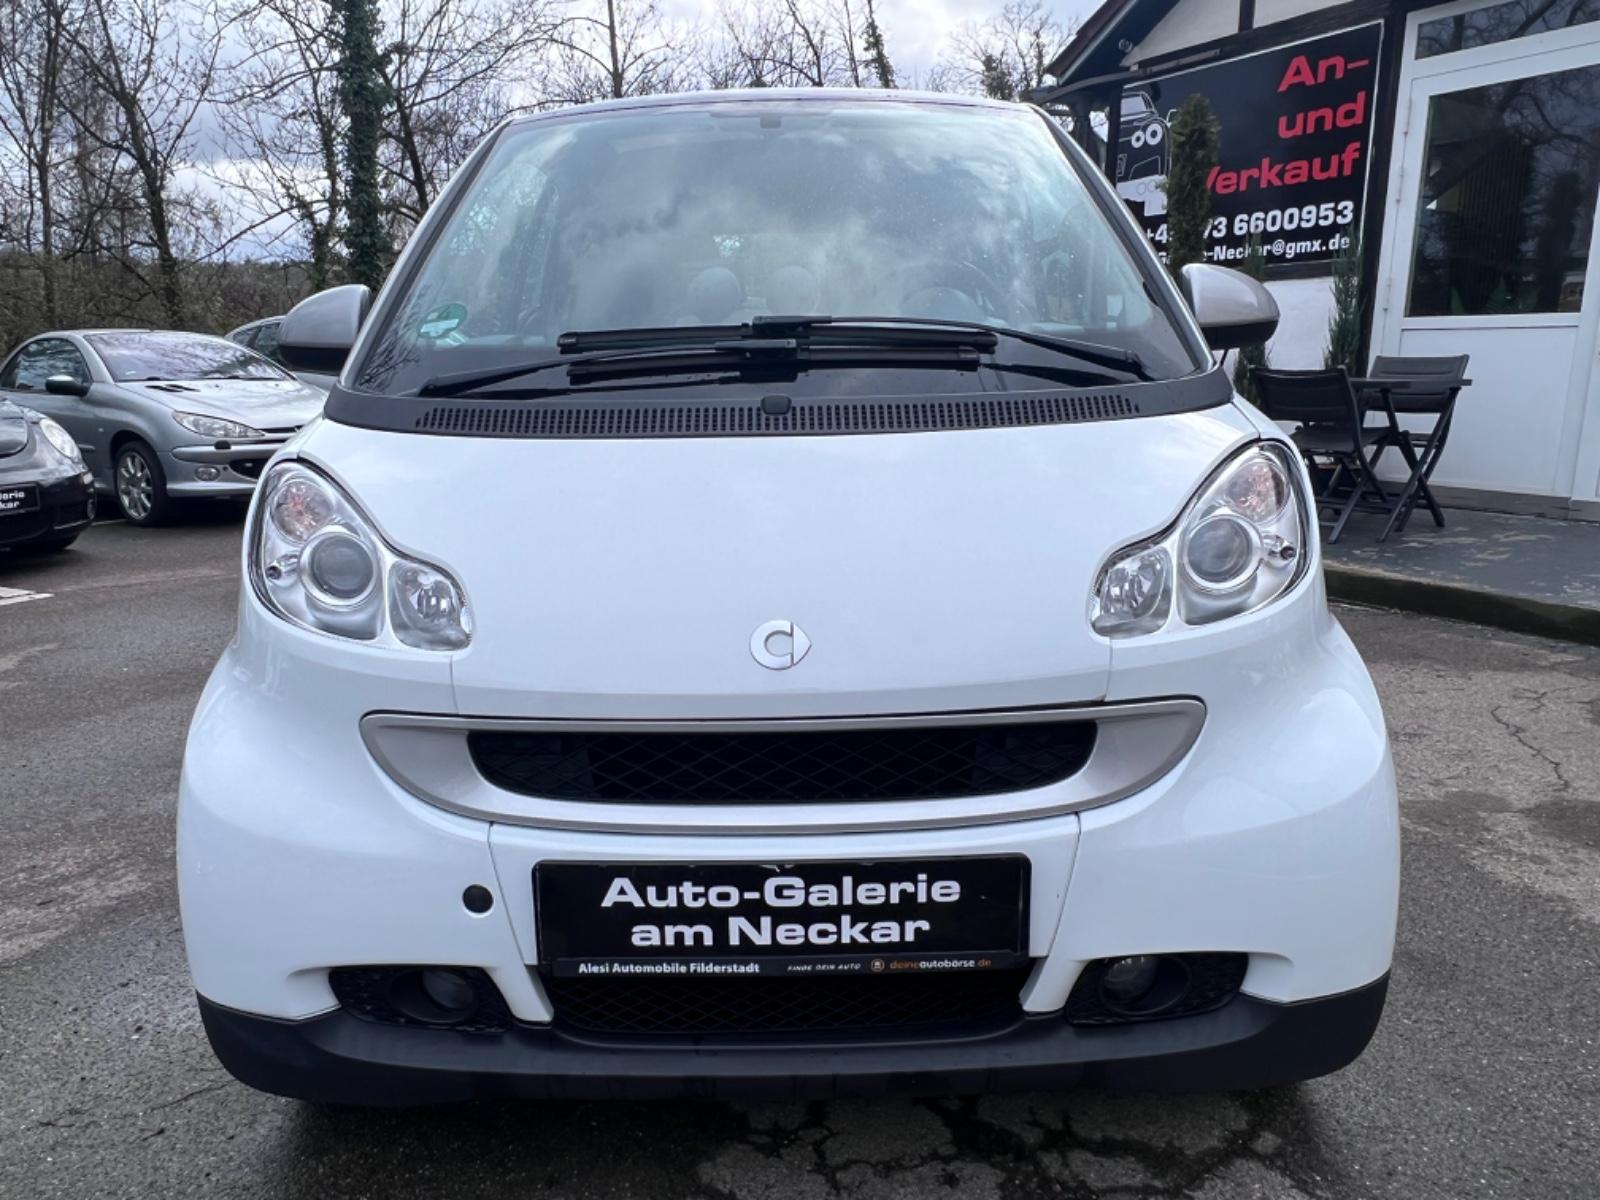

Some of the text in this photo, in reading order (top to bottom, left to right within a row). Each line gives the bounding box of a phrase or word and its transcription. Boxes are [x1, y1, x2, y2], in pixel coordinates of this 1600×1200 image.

[1277, 55, 1369, 92] An-
[1278, 91, 1366, 139] und
[1233, 200, 1354, 236] 6600953
[600, 873, 961, 909] Auto-Galerie
[631, 915, 931, 947] am Neckar
[578, 962, 760, 974] Alesi Automobile Filderstadt
